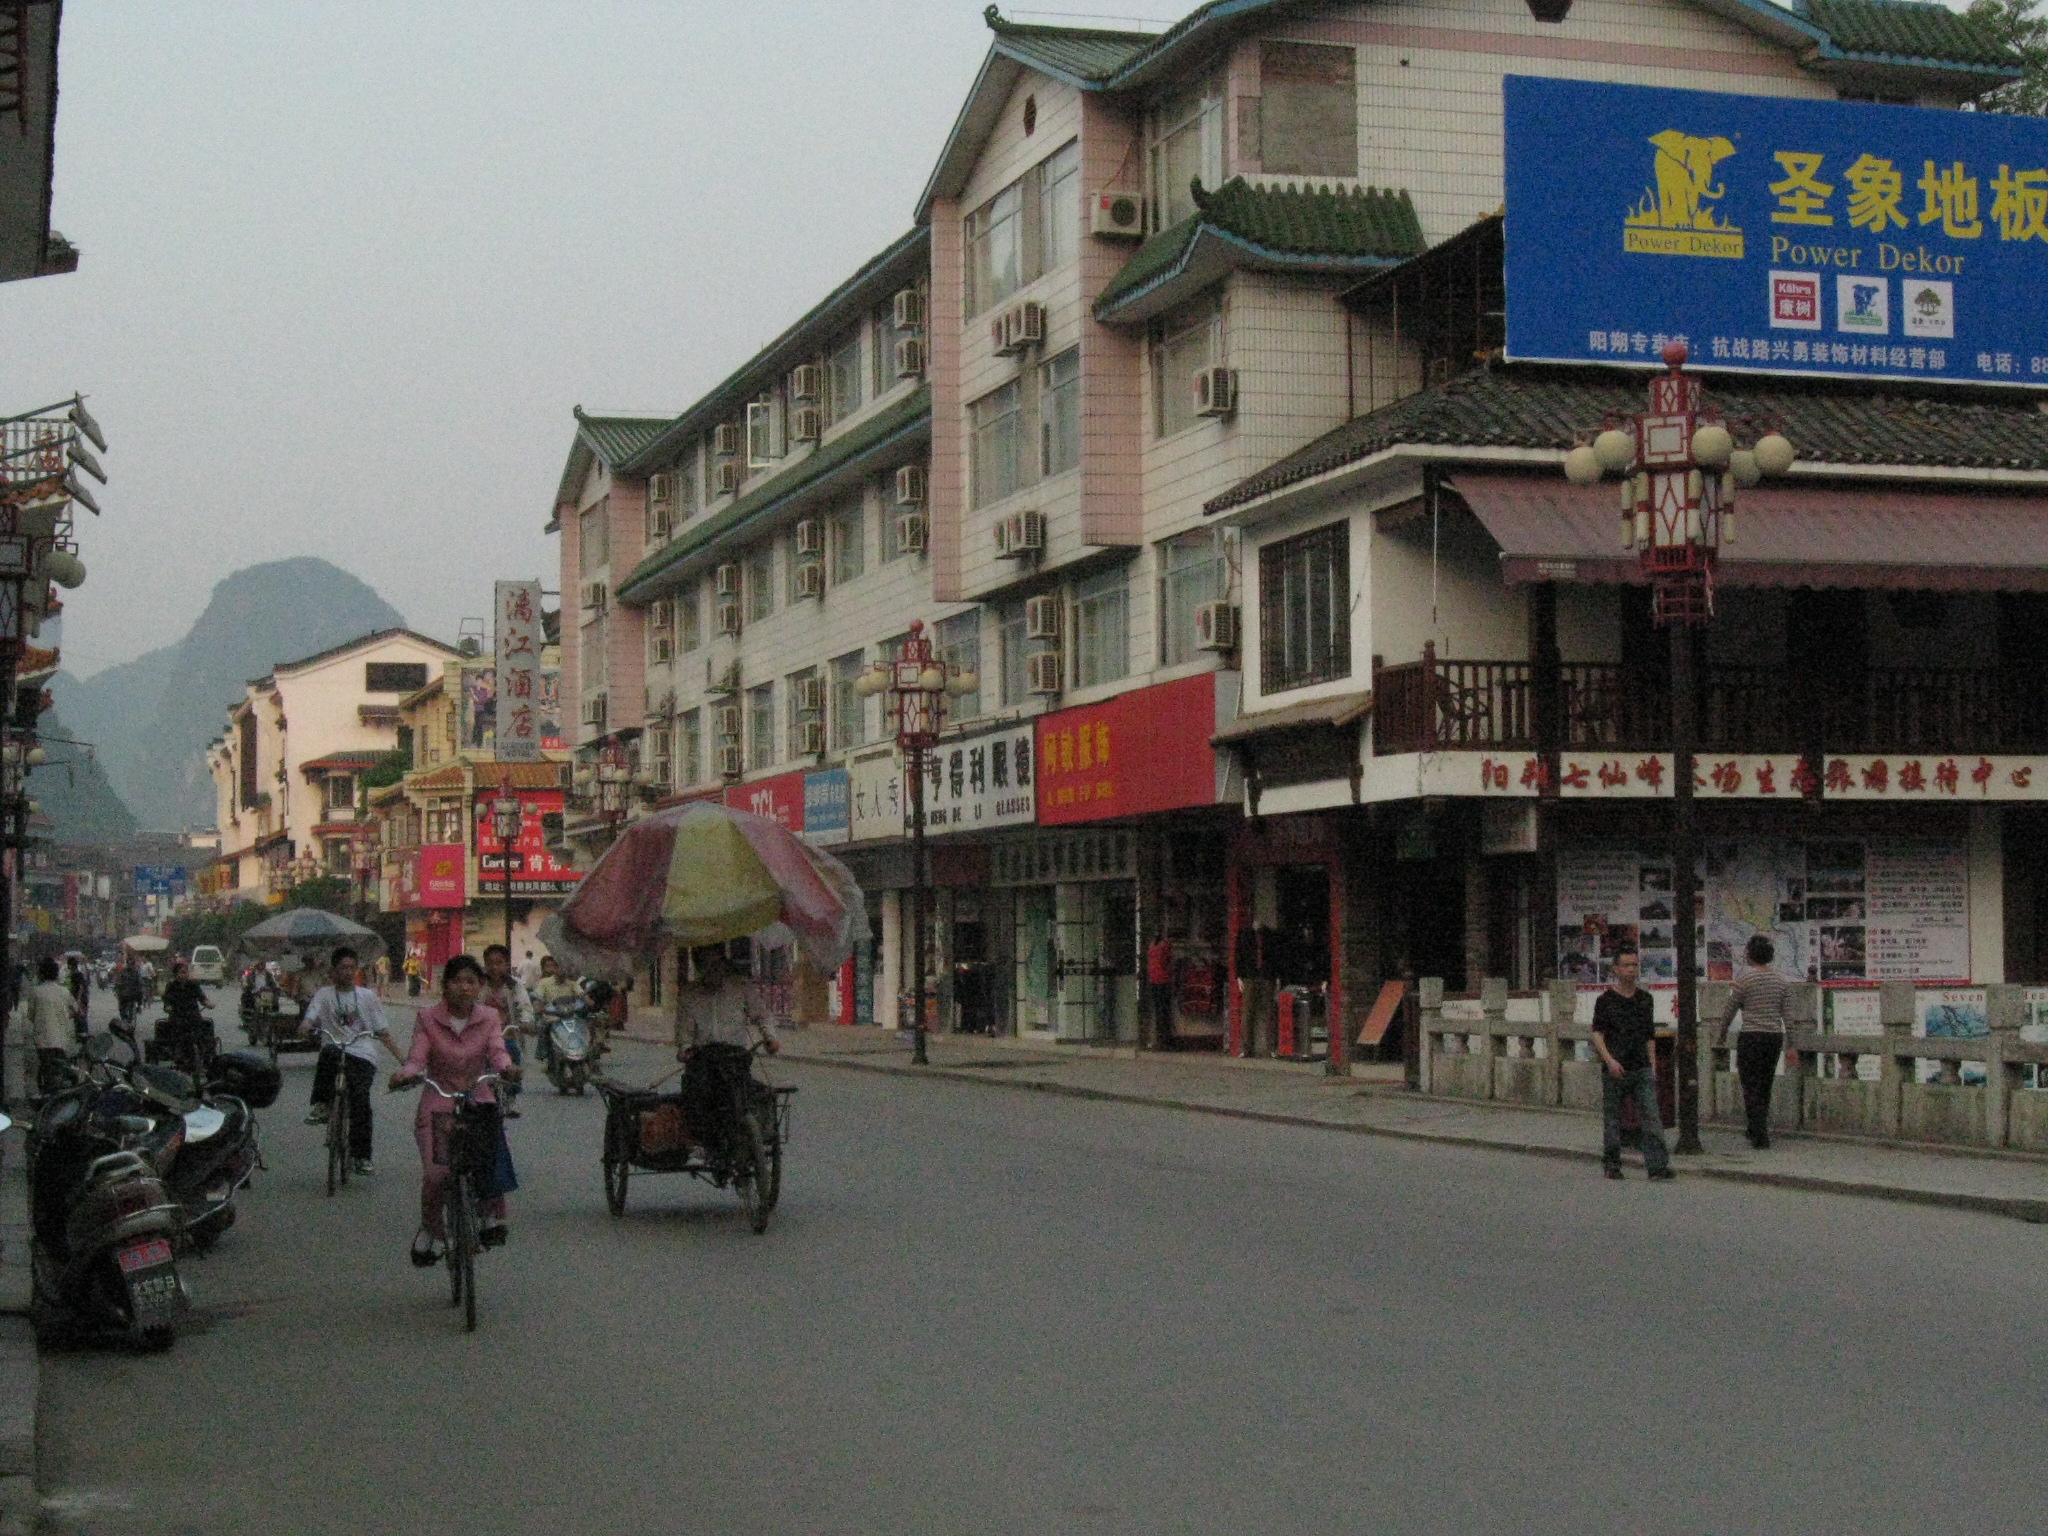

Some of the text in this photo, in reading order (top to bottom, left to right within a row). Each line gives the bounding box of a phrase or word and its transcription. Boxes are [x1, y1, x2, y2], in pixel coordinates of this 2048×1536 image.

[1768, 151, 2048, 244] 圣象地板
[1627, 233, 1740, 254] Power Dekor
[1770, 236, 1965, 275] Power Dekor
[503, 588, 533, 738] 漓江酒店
[1942, 991, 1984, 1002] Seven
